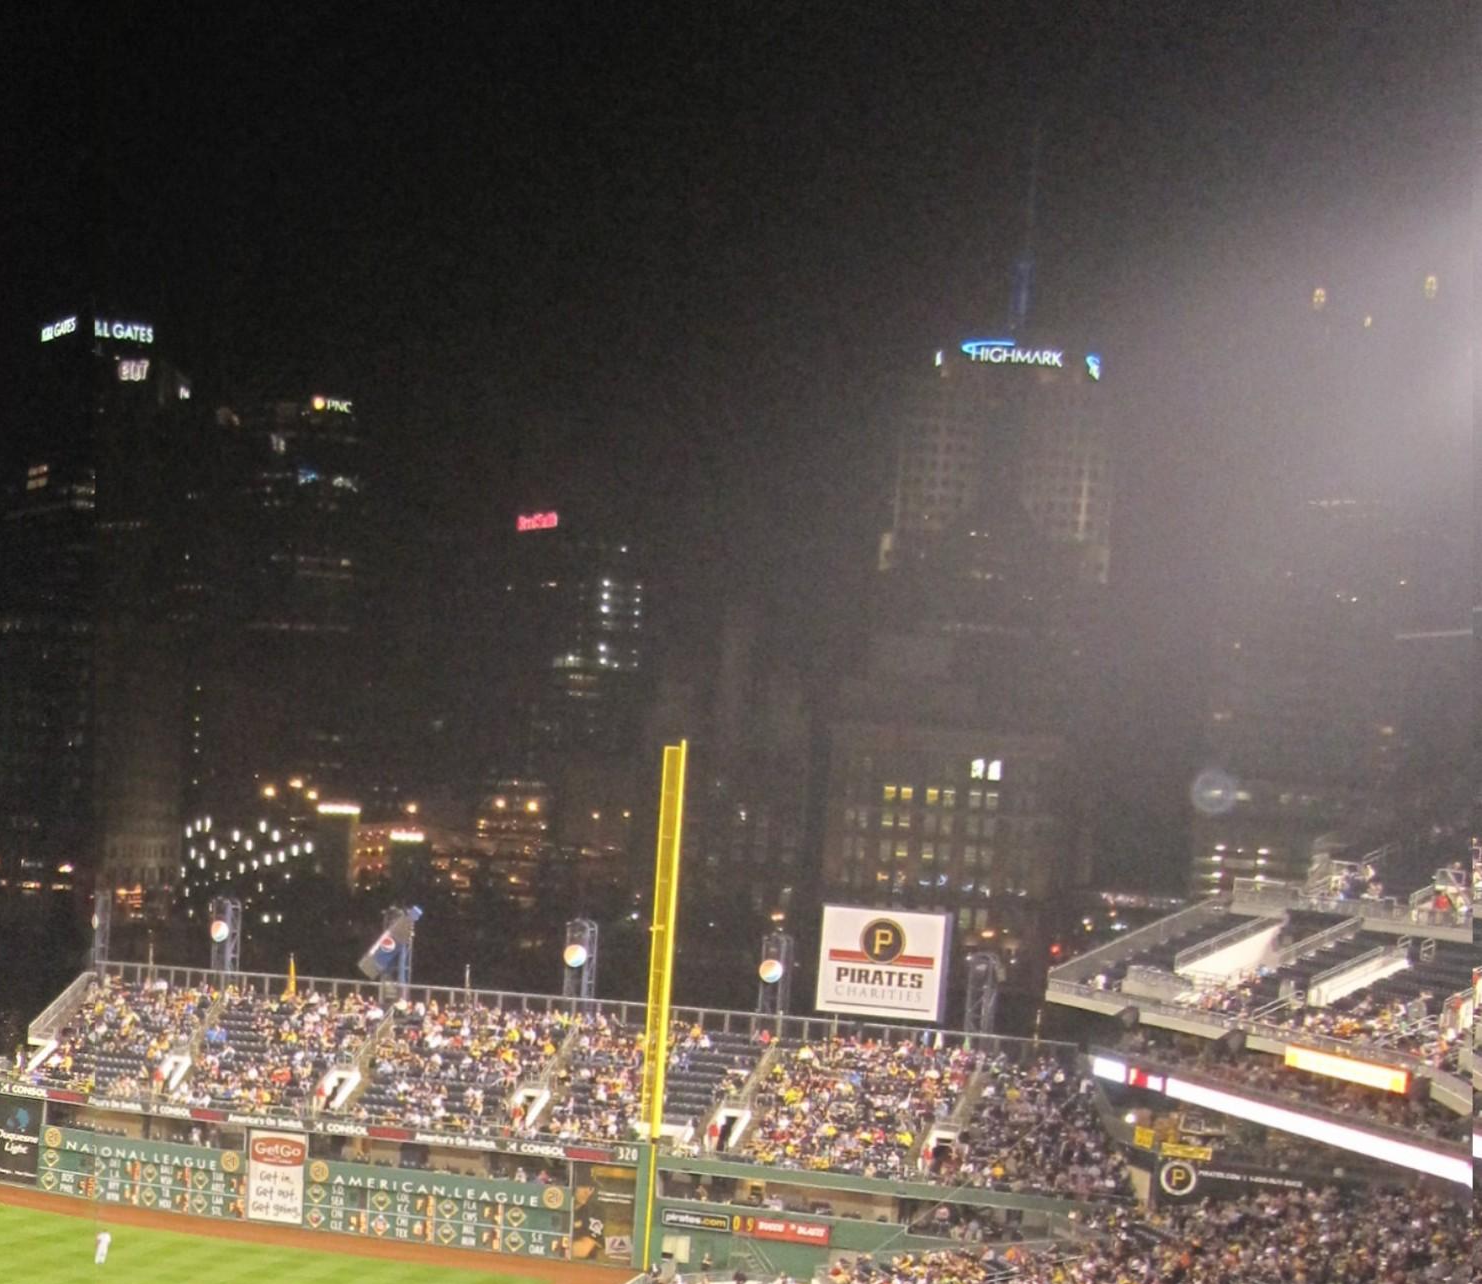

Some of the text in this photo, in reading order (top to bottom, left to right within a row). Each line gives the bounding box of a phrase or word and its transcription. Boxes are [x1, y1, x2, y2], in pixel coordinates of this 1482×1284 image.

[54, 316, 77, 337] GATES
[112, 324, 154, 343] GATES
[971, 347, 1063, 368] HIGHMARK
[327, 400, 352, 413] PNC
[874, 929, 893, 955] P
[836, 966, 924, 989] PIRATES
[835, 985, 923, 1003] CHARITIES
[12, 1084, 48, 1098] CONSOL
[159, 1106, 191, 1118] CONSOL
[327, 1122, 369, 1136] CONSOL
[415, 1131, 454, 1145] America's
[467, 1137, 497, 1149] Switch
[4, 1142, 29, 1155] Light
[255, 1142, 302, 1157] GetGo
[521, 1143, 566, 1157] CONSOL
[617, 1147, 638, 1161] 320
[154, 1153, 217, 1171] LEAGUE
[259, 1170, 278, 1183] Get
[1171, 1168, 1185, 1187] P
[256, 1186, 274, 1200] Get
[334, 1174, 539, 1207] AMERICAN LEAGUE
[665, 1212, 726, 1228] pirates.com
[528, 1244, 545, 1255] OAK
